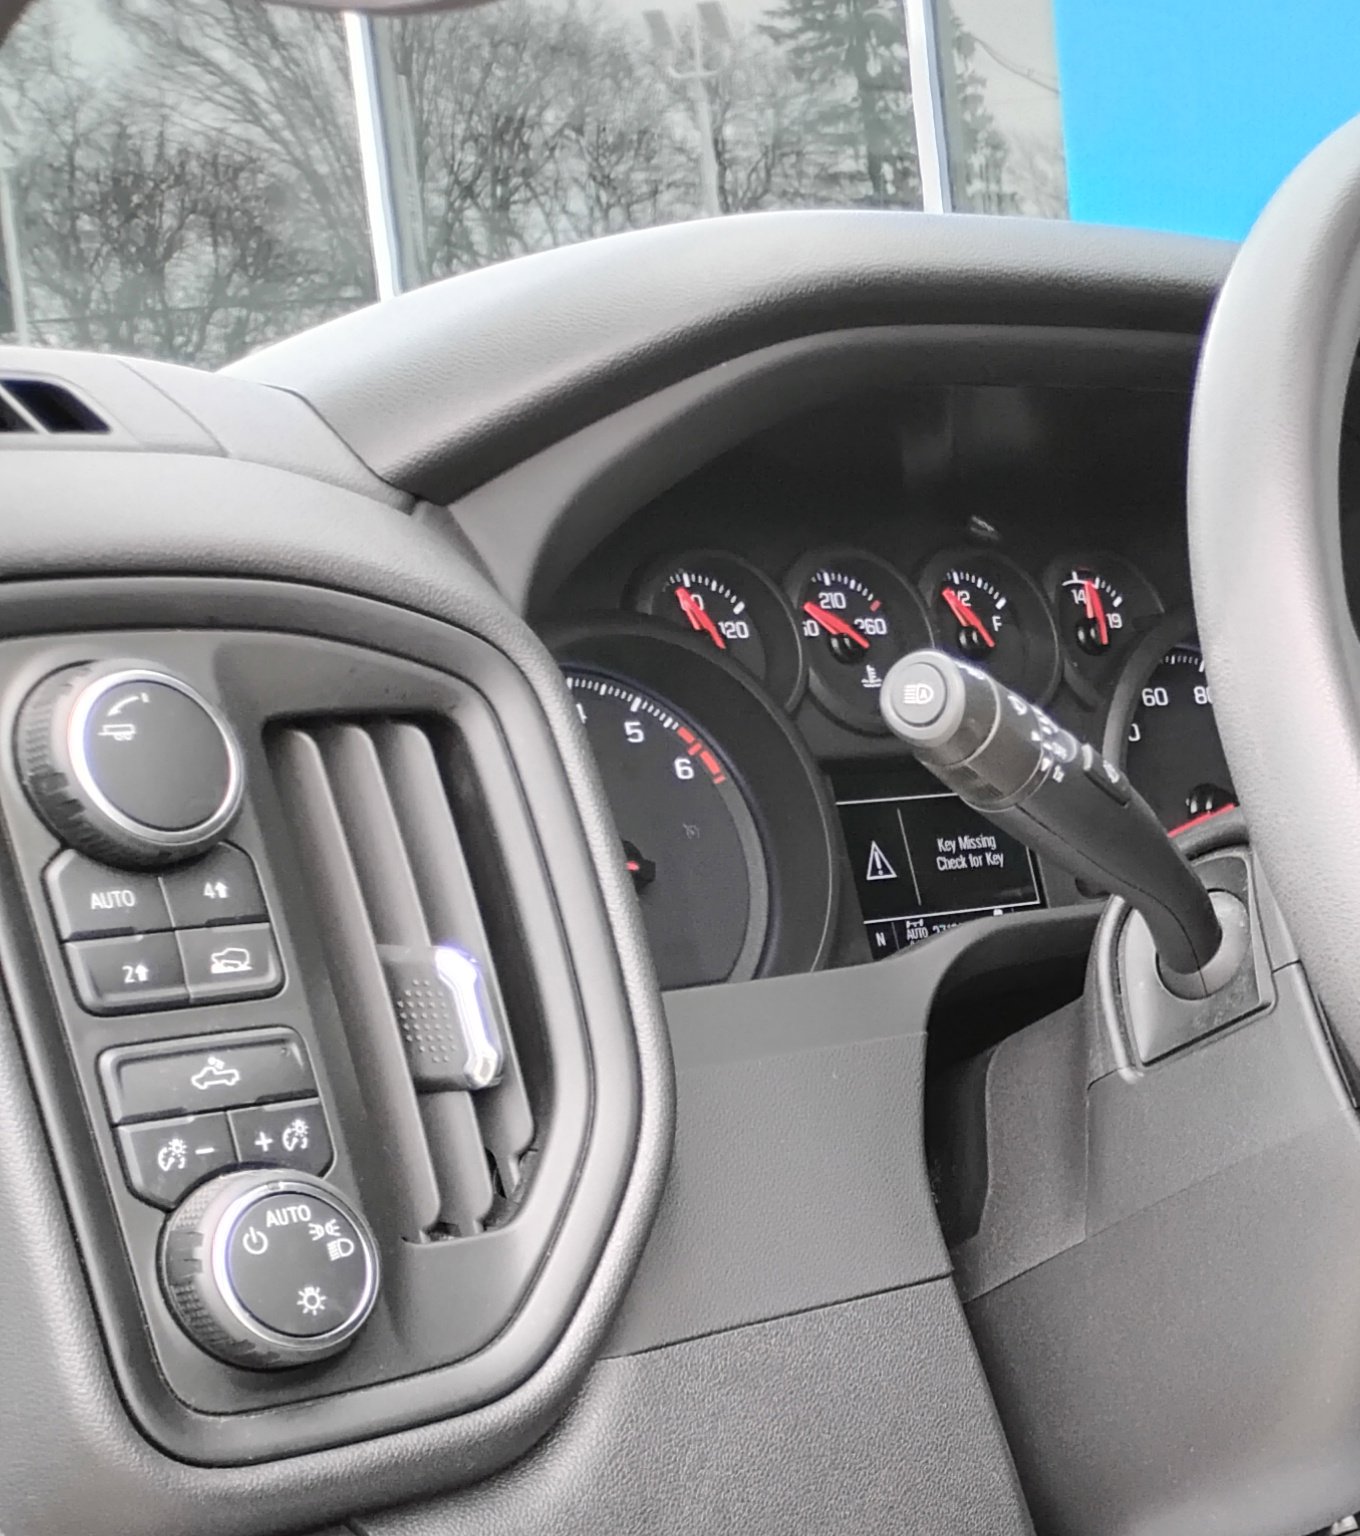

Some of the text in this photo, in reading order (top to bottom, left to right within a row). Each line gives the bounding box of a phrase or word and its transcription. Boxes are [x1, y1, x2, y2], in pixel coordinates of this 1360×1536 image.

[818, 592, 848, 609] 210
[717, 621, 750, 639] 120
[992, 615, 1003, 632] F
[1105, 613, 1123, 629] 19
[1141, 686, 1169, 707] 60
[624, 721, 645, 743] 5
[674, 756, 695, 780] 6
[937, 834, 997, 854] Key Missing
[936, 852, 1004, 871] Check for Key
[90, 889, 136, 910] AUTO
[203, 882, 216, 899] 4
[875, 932, 886, 947] N
[907, 927, 928, 940] AUTO
[122, 965, 135, 983] 2
[266, 1204, 311, 1228] AUTO
